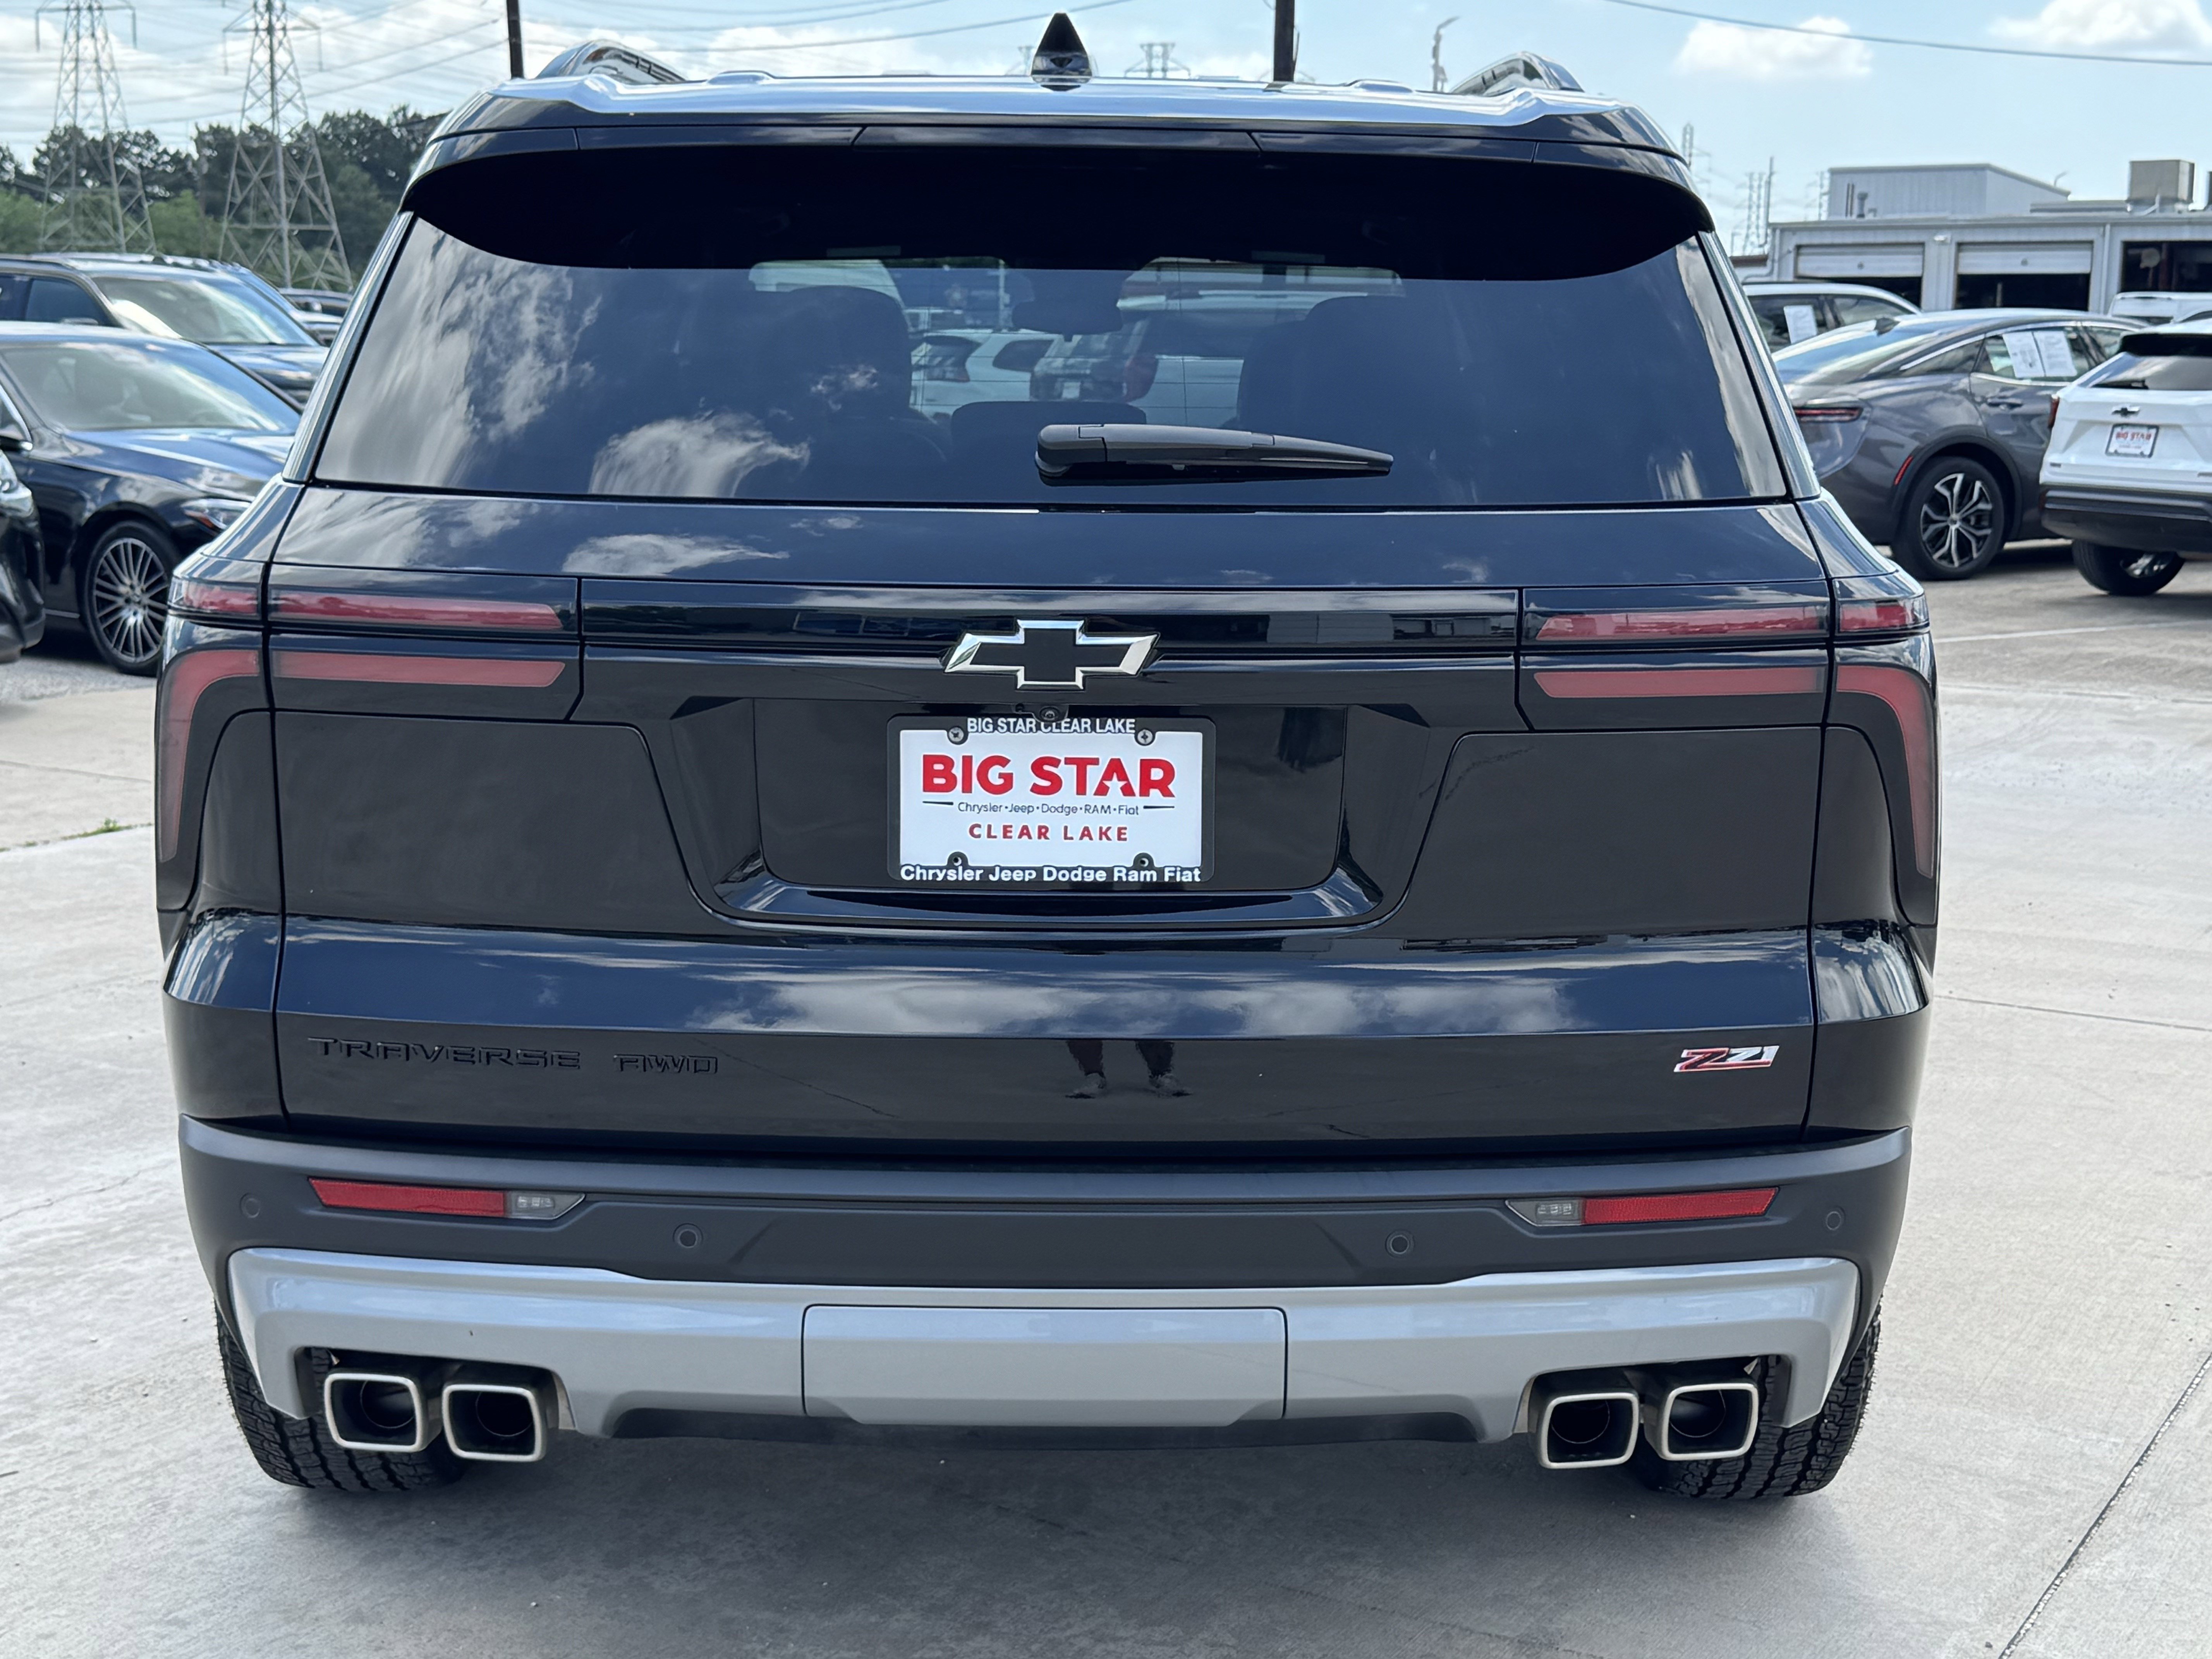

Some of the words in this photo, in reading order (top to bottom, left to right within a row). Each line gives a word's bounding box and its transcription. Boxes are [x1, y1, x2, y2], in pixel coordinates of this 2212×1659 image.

[967, 718, 993, 732] BIG
[997, 718, 1036, 733] STAR
[1041, 718, 1091, 733] CLEAR
[1096, 718, 1135, 733] LAKE
[923, 754, 1013, 795] BIG
[1030, 756, 1175, 797] STAR
[969, 823, 1050, 840] CLEAR
[1063, 825, 1128, 841] LAKE
[900, 866, 984, 881] Chrysler
[989, 866, 1037, 881] Jeep
[1043, 866, 1107, 881] Dodge
[1113, 867, 1157, 882] Ram
[1164, 867, 1201, 882] Fiat
[307, 1037, 580, 1069] TRAVERSE
[614, 1053, 718, 1074] AWD
[1673, 1045, 1779, 1072] Z71
